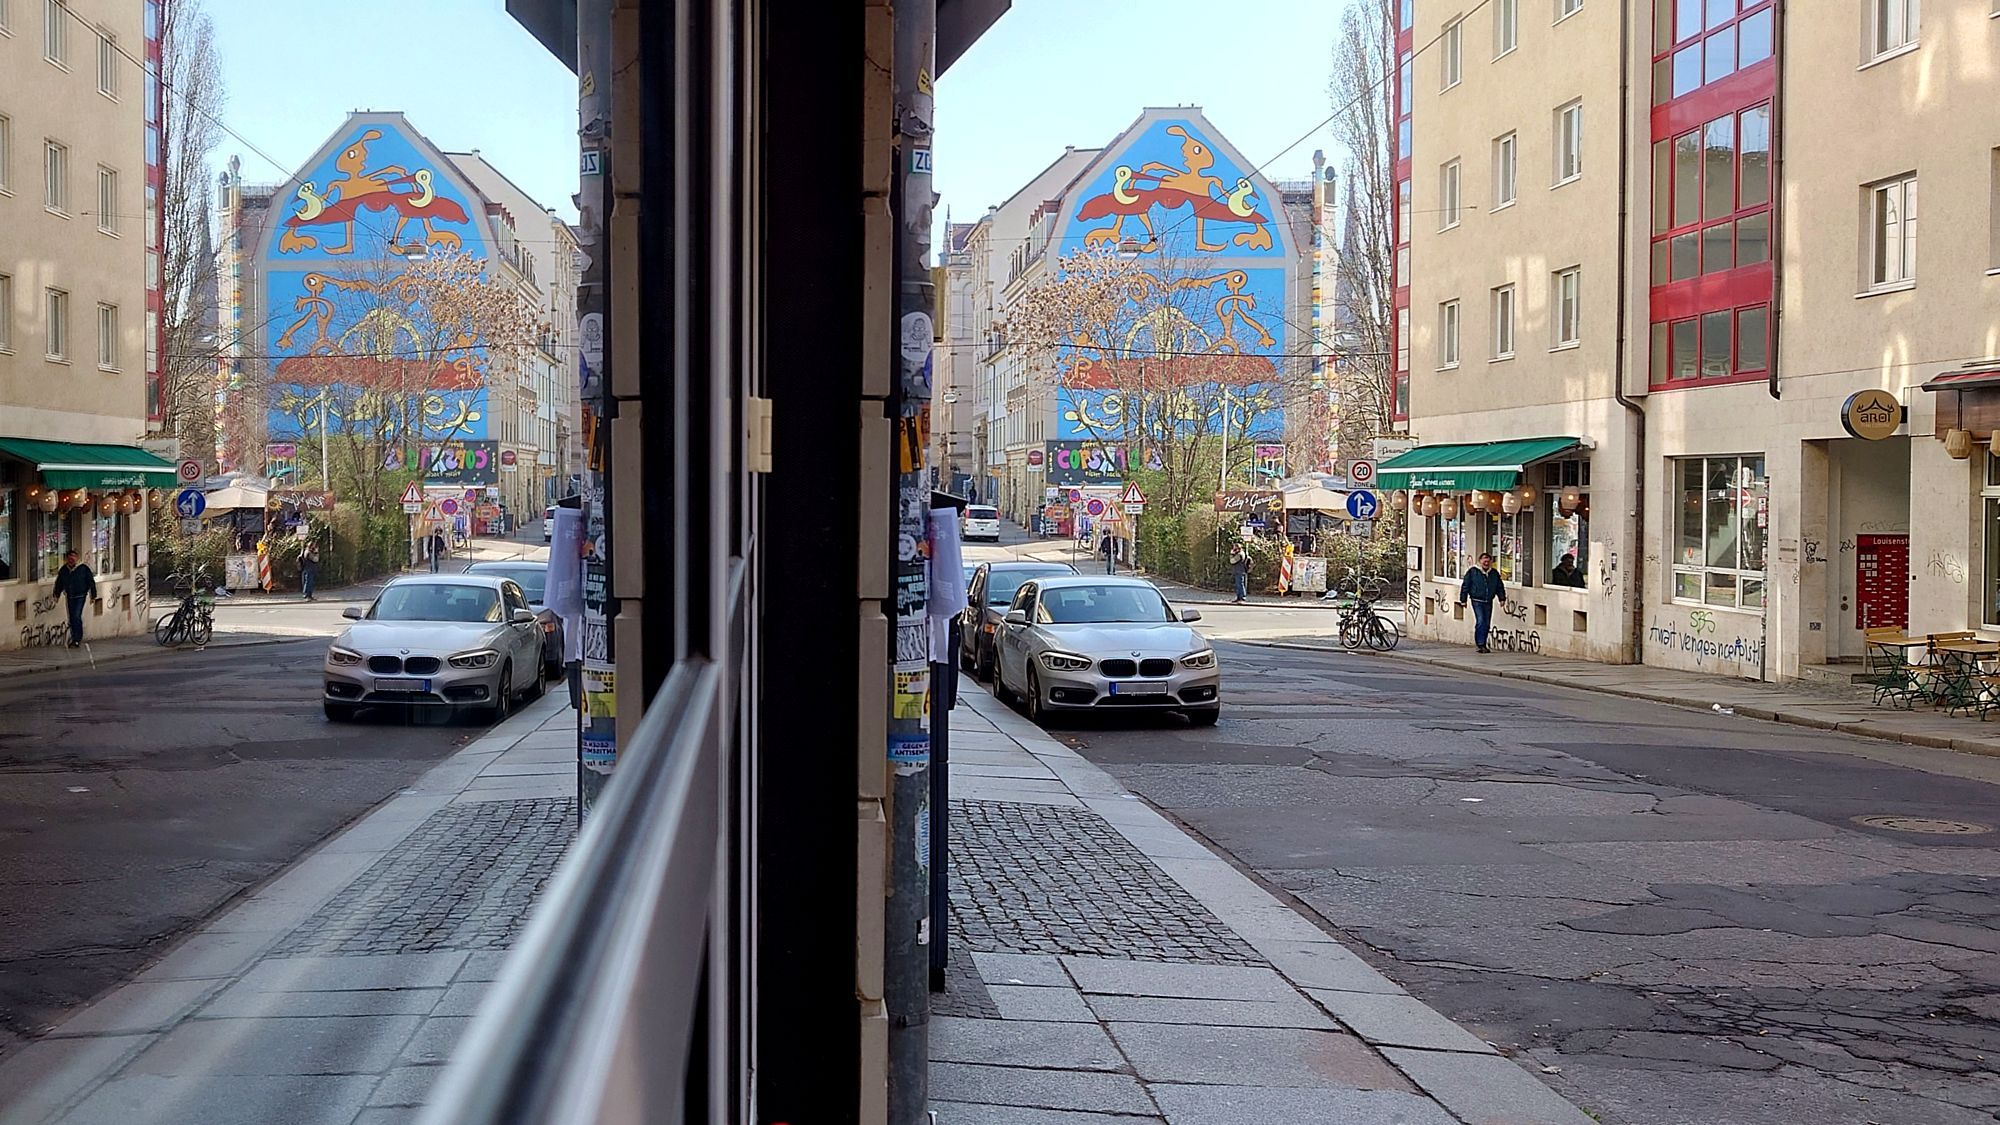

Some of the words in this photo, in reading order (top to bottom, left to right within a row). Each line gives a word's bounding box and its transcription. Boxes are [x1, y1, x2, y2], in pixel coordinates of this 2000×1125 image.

[1356, 466, 1368, 476] 20
[1224, 492, 1249, 509] Katy's
[1250, 493, 1277, 511] Garage
[1679, 632, 1734, 665] vengeance
